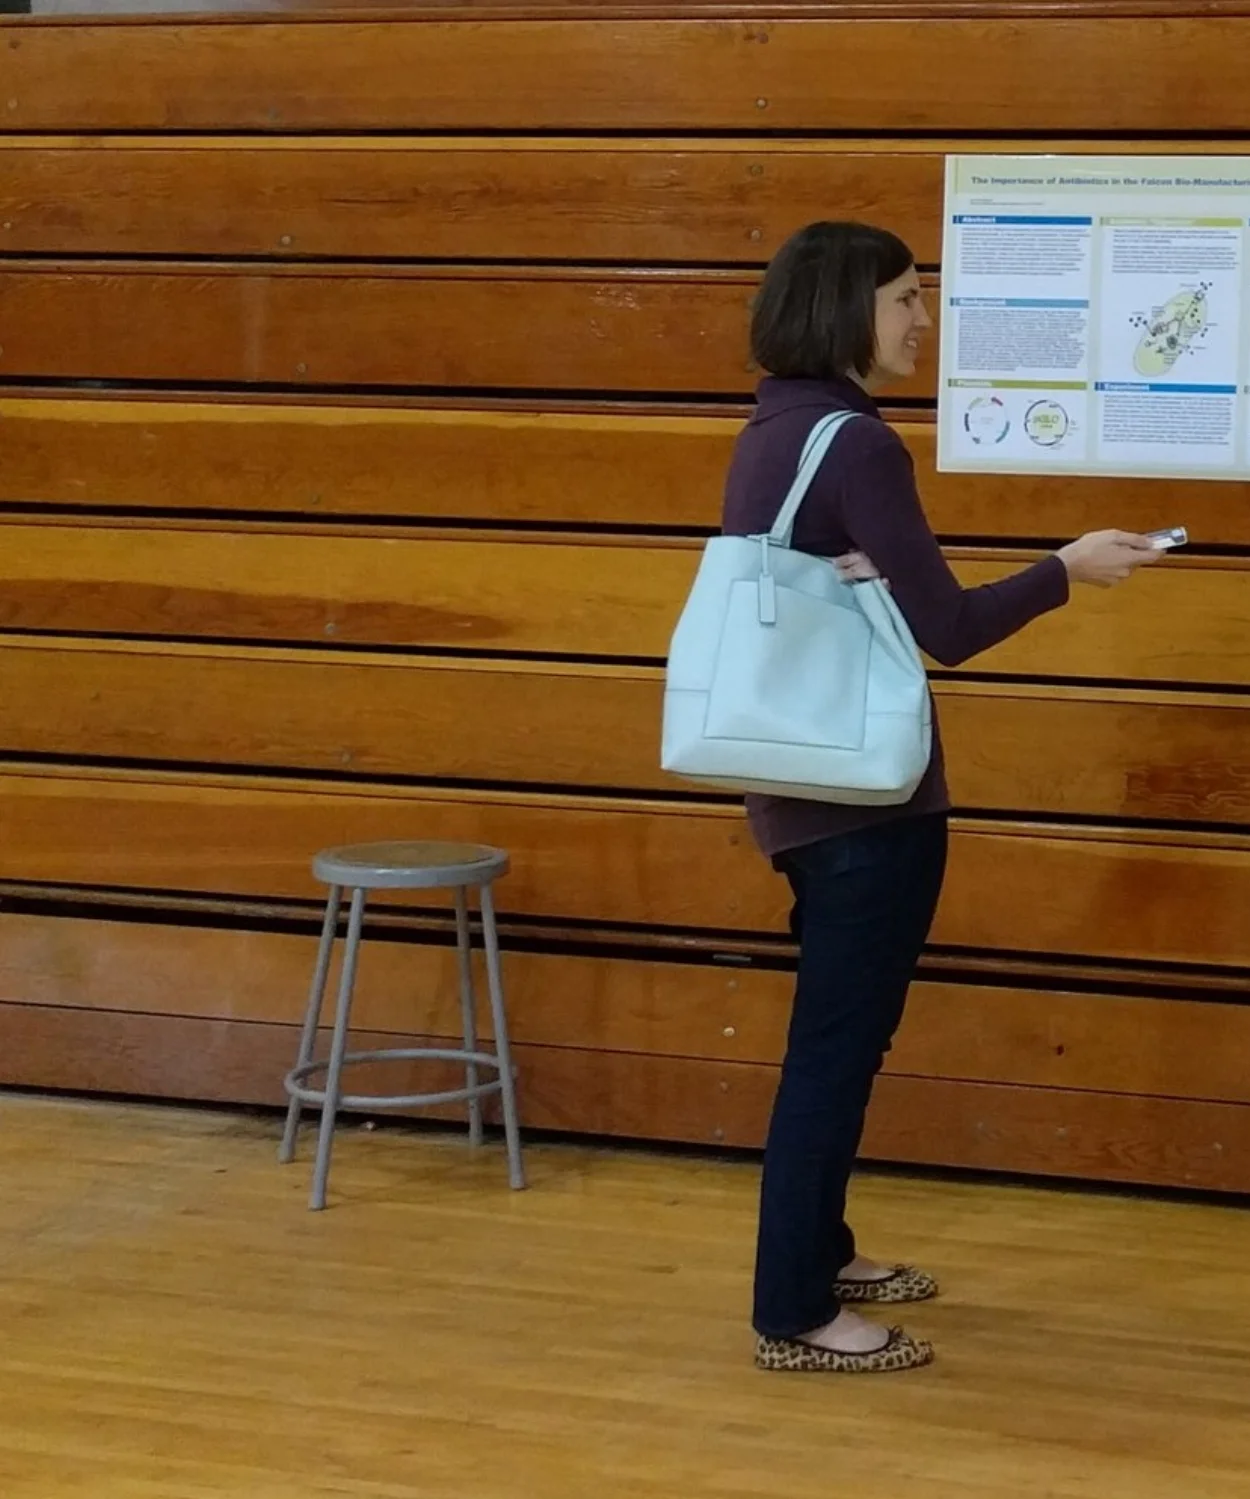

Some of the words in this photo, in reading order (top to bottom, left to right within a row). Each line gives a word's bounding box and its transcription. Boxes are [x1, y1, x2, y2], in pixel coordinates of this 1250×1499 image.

[971, 176, 988, 185] The
[991, 176, 1044, 186] Importance
[1047, 176, 1056, 185] of
[1059, 177, 1109, 185] Antibiotics
[1111, 177, 1121, 185] in
[1123, 177, 1138, 186] the
